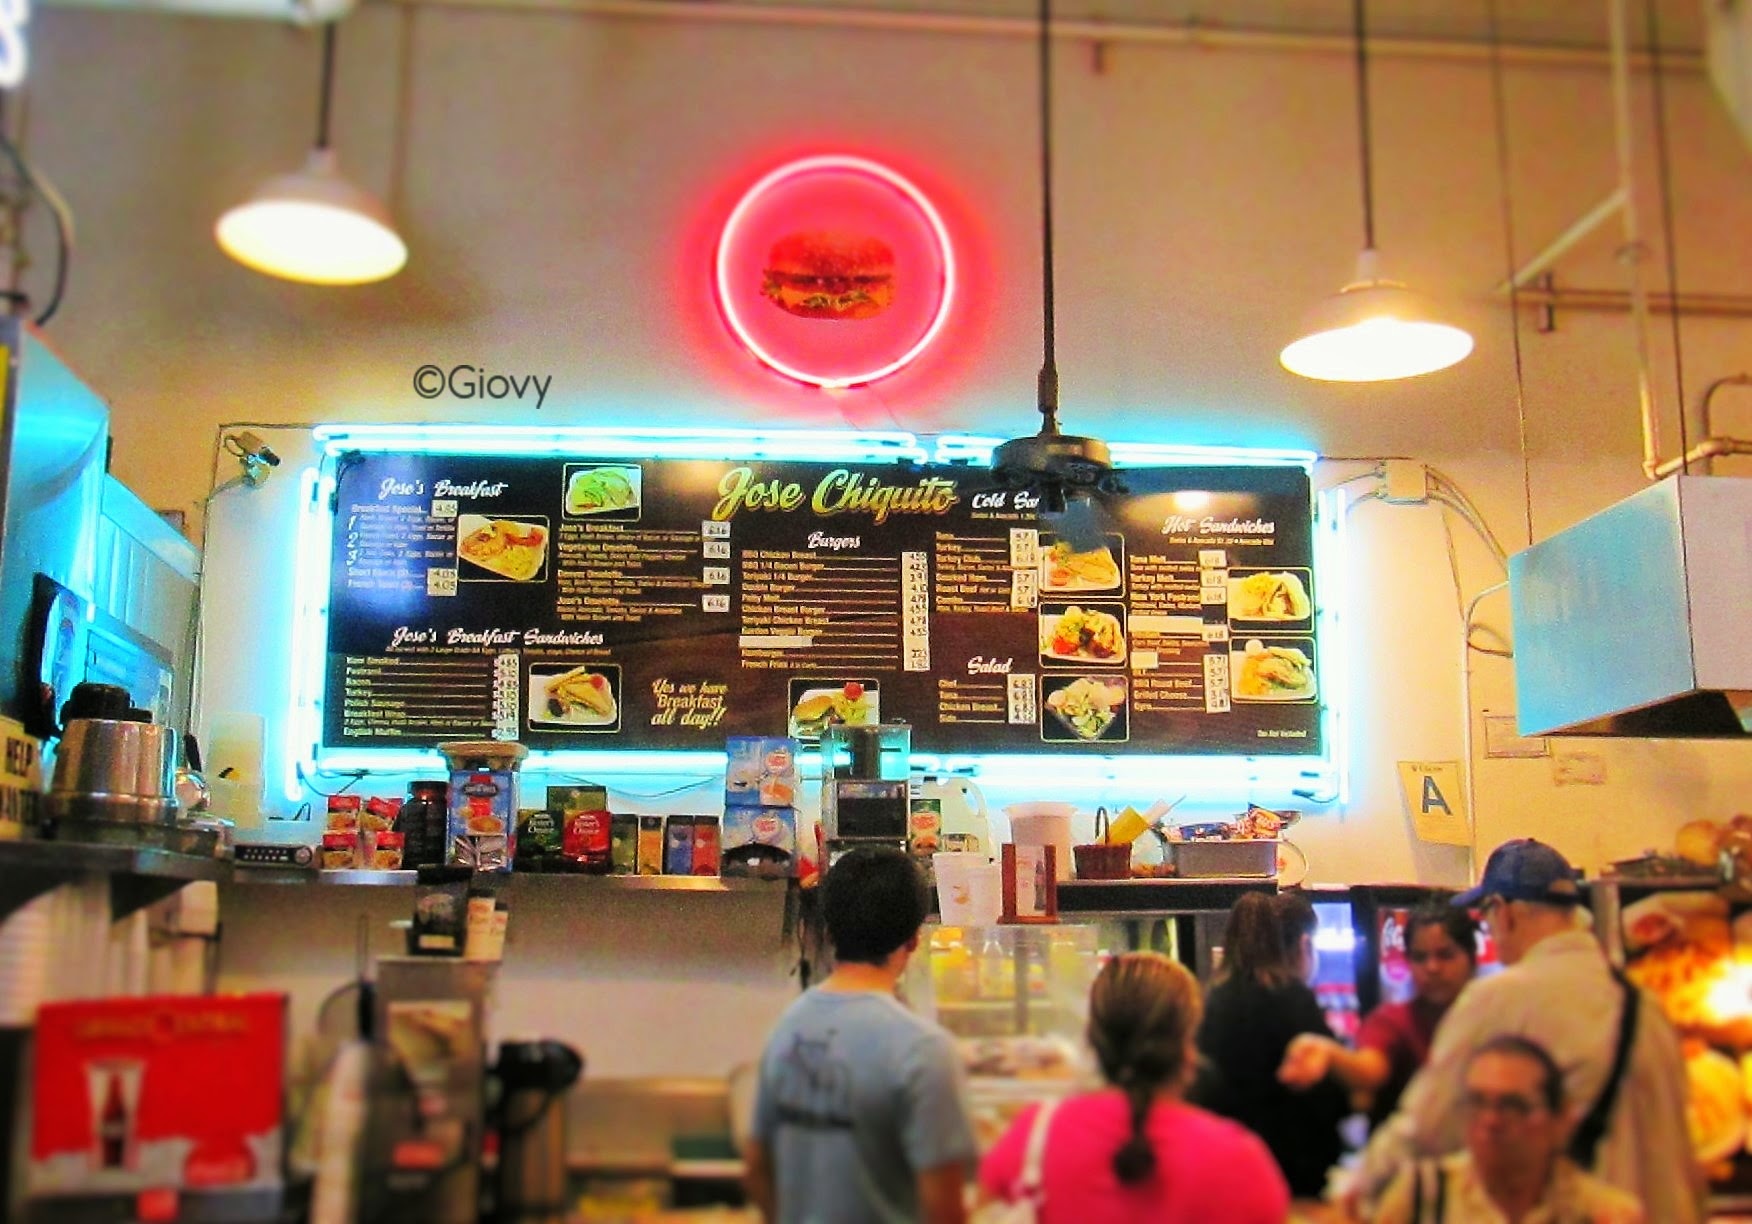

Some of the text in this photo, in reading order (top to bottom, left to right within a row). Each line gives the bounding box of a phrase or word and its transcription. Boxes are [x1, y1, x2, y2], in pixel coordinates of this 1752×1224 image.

[434, 479, 508, 499] Breakfast
[711, 467, 961, 526] Jose Chiquito
[971, 491, 1007, 509] Cold
[1199, 516, 1275, 534] Sandwiches
[807, 531, 861, 550] Burgers
[447, 627, 521, 647] Breakfast
[523, 628, 604, 646] Sandwiches
[967, 655, 1013, 675] Salad
[657, 693, 724, 709] Breakfast
[4, 735, 33, 778] HELP
[1422, 775, 1454, 816] A
